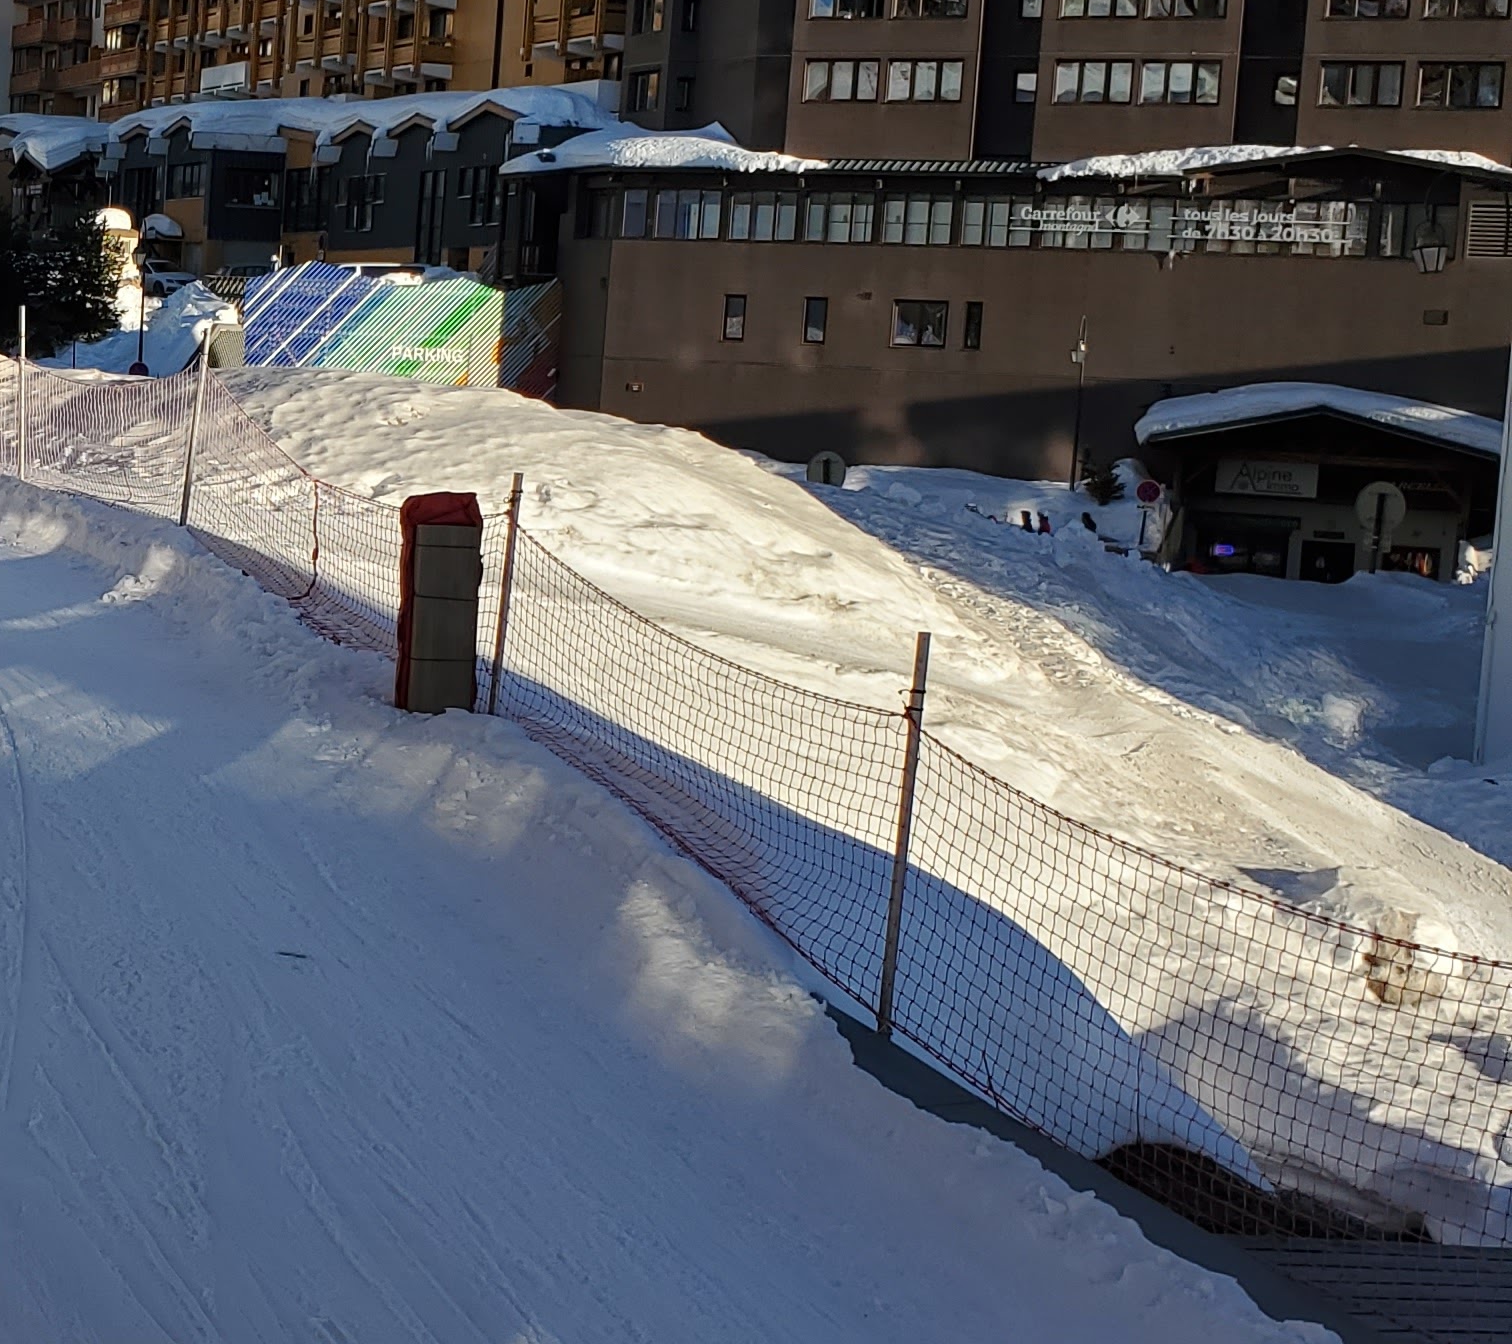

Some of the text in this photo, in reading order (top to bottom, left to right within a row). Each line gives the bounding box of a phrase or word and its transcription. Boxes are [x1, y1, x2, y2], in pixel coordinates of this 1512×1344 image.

[1020, 206, 1100, 221] Carrefour
[1184, 209, 1296, 225] tous les jours
[1182, 227, 1201, 239] de
[1205, 225, 1254, 240] 7h30
[1271, 226, 1334, 243] 20h30
[391, 346, 463, 363] PARKING
[1230, 462, 1293, 491] Alpine
